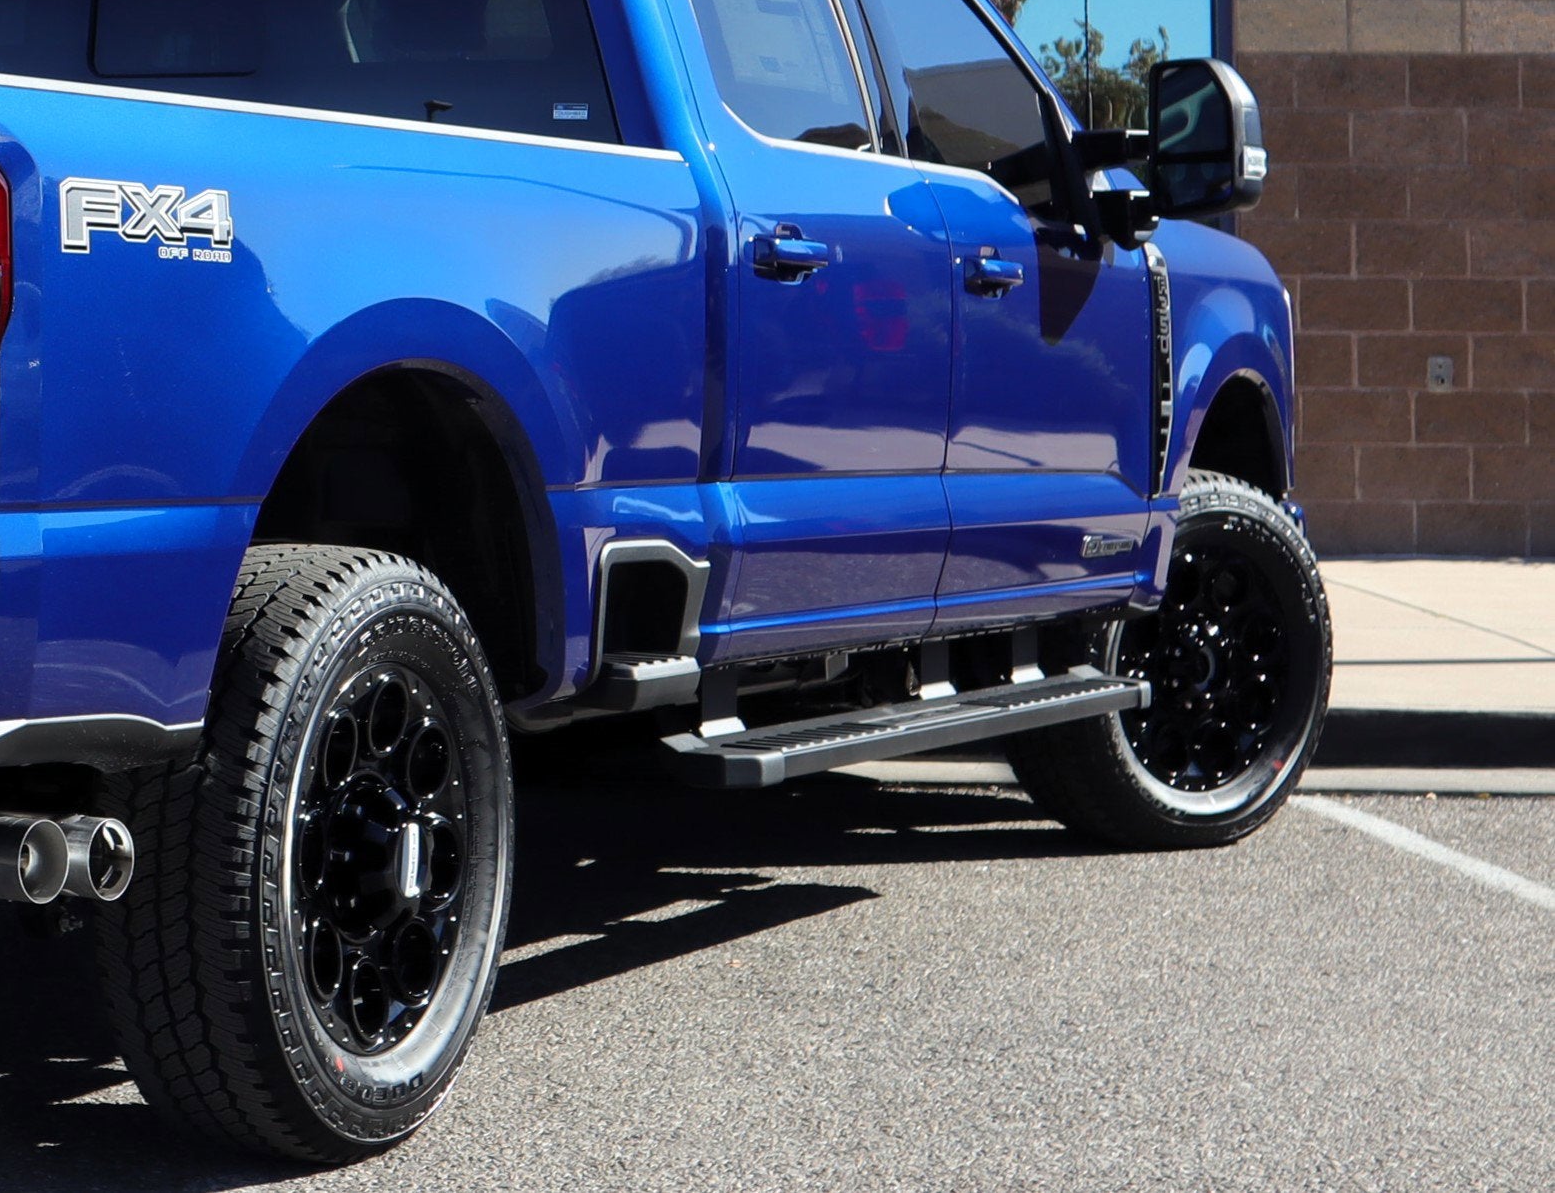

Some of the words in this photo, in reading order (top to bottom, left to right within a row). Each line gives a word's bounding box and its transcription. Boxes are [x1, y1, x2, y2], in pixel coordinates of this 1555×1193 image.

[59, 177, 234, 255] FX4
[158, 246, 189, 260] OFF
[193, 249, 233, 263] ROAD
